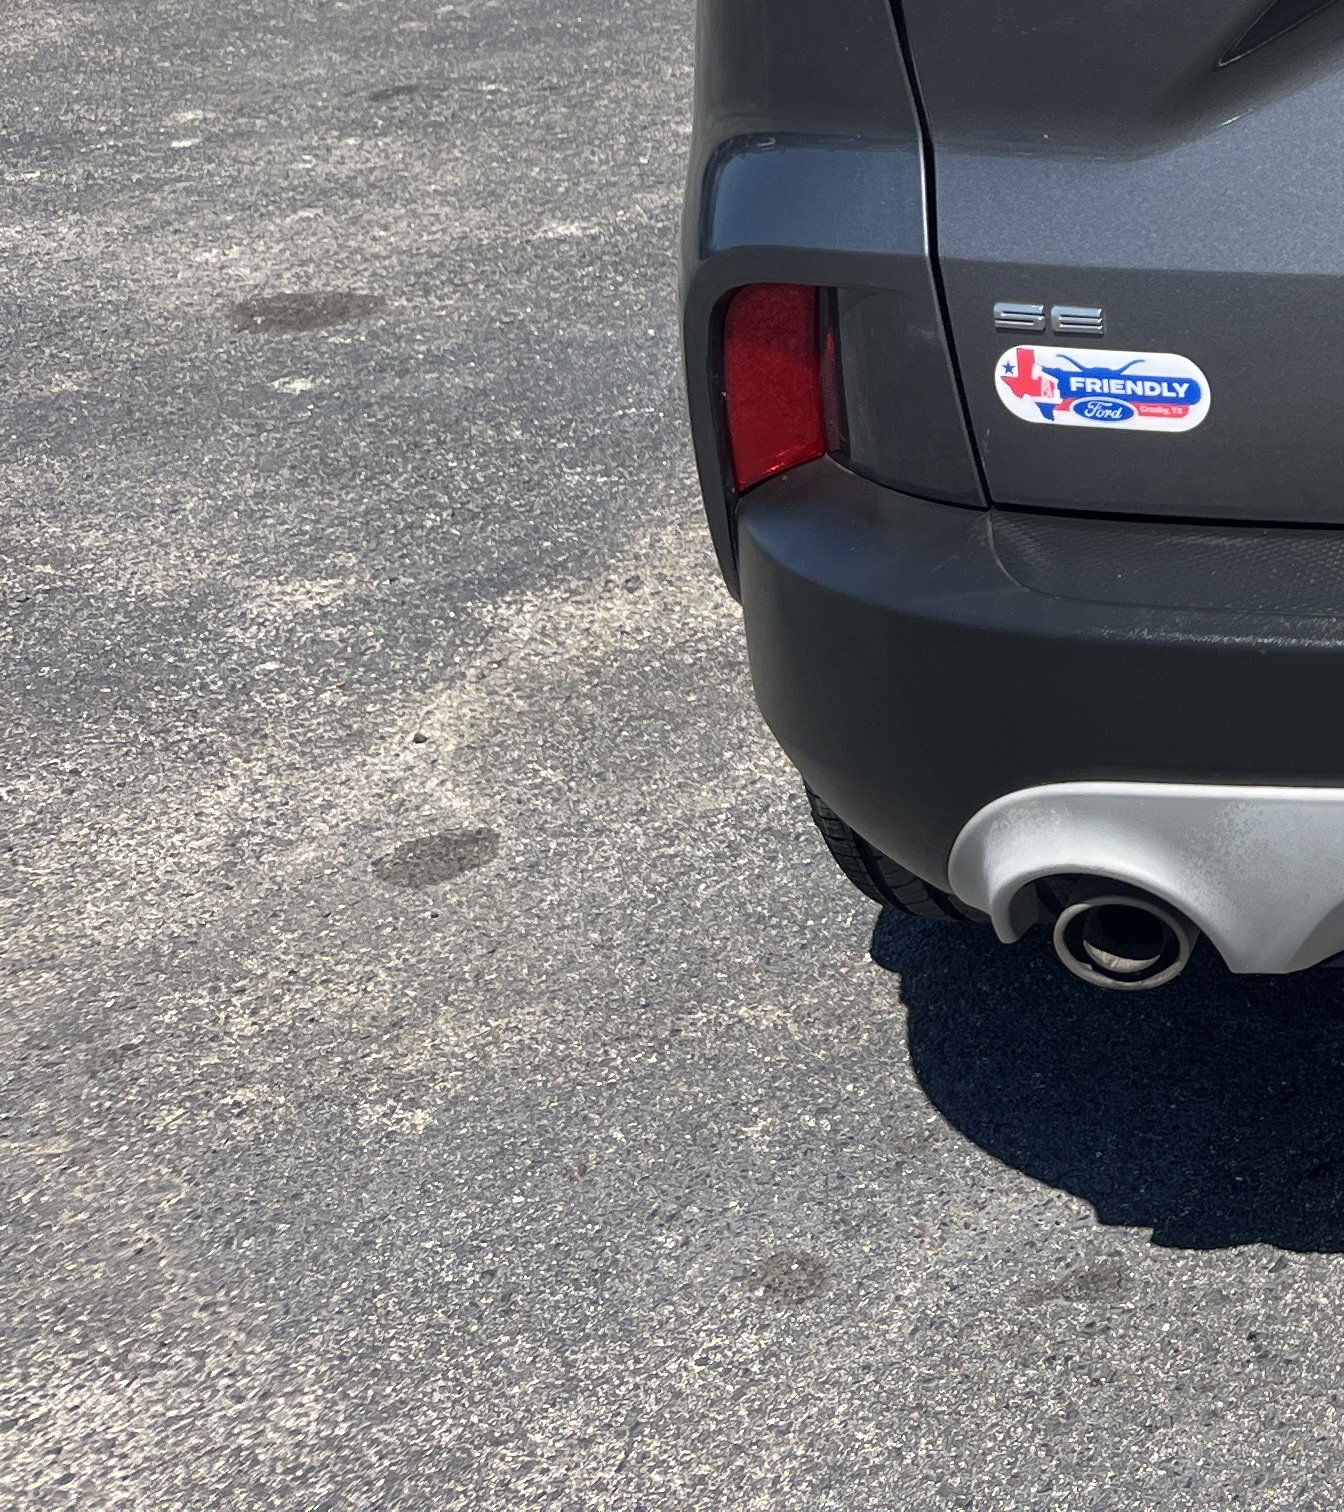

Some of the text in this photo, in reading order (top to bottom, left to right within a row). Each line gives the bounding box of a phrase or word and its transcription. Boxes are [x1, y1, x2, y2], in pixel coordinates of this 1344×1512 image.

[993, 301, 1105, 334] SE
[1069, 376, 1191, 399] FRIENDLY
[1083, 400, 1123, 419] Ford
